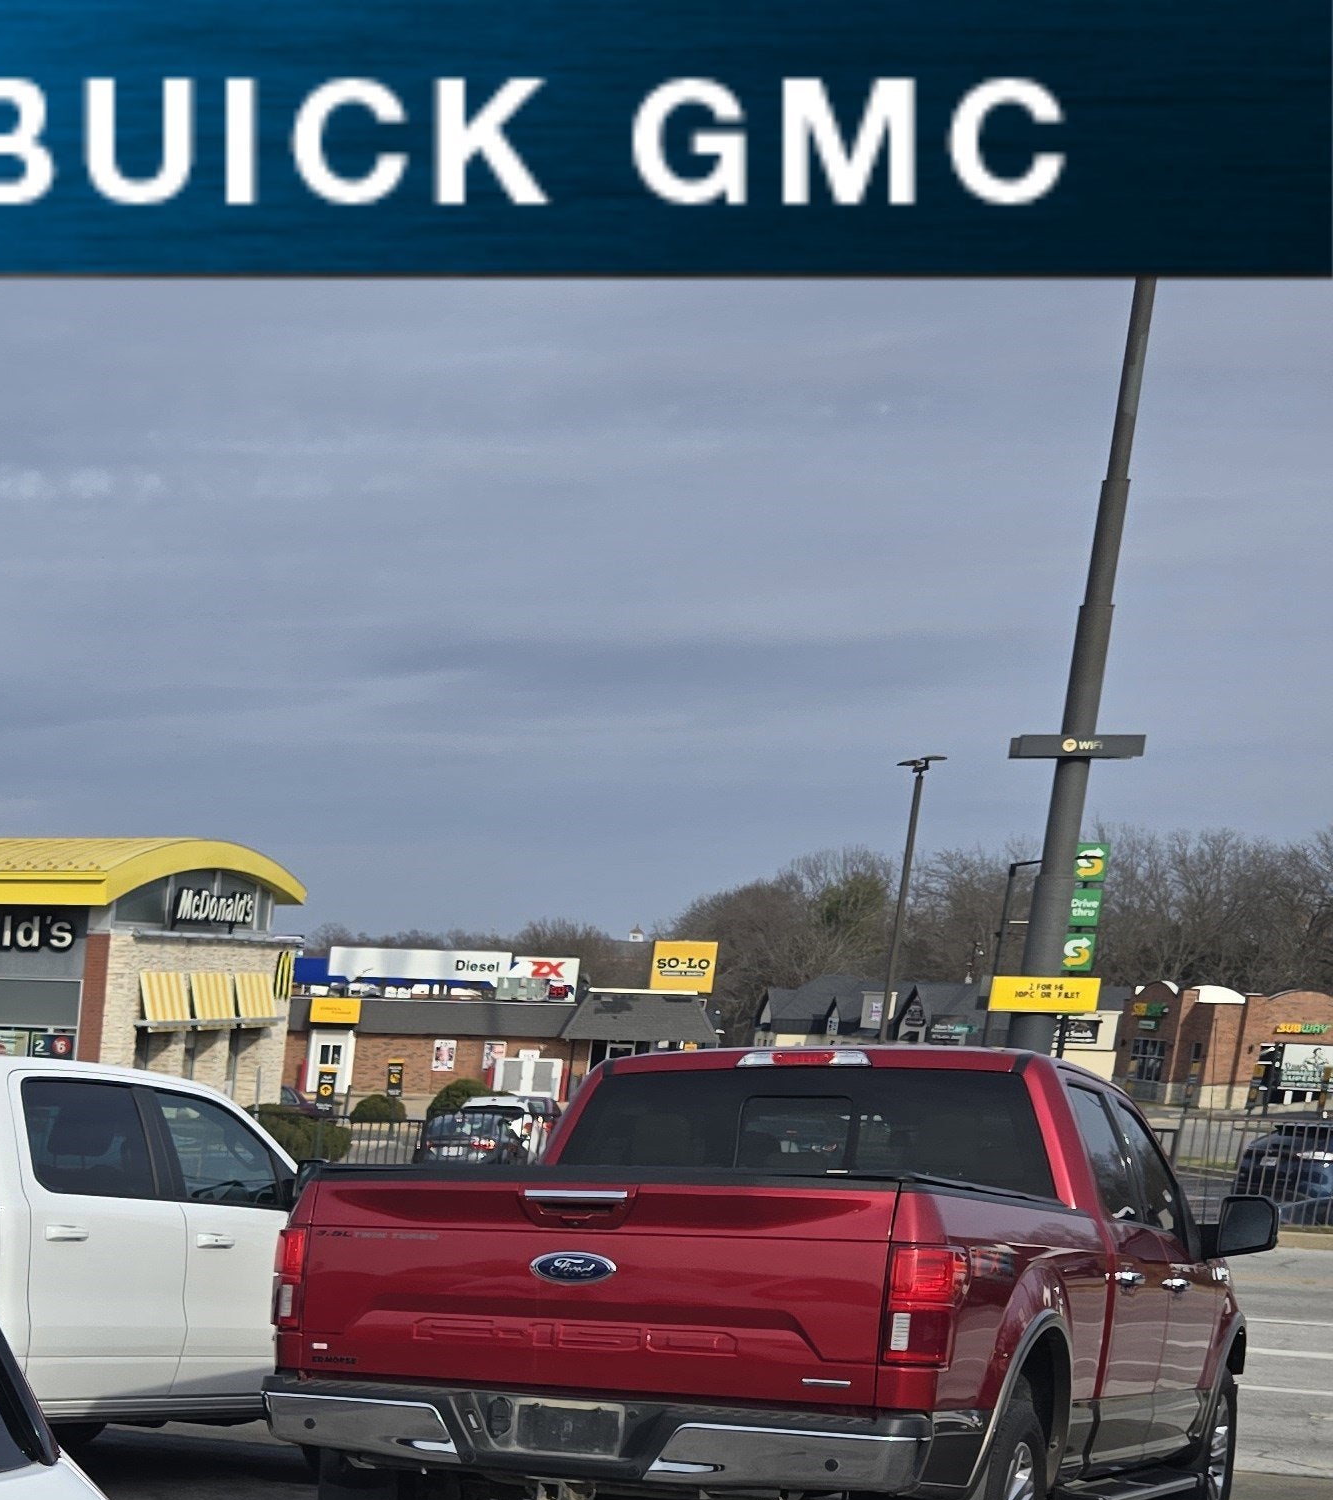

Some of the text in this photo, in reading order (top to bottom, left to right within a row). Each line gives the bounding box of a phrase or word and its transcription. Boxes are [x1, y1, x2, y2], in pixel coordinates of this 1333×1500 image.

[176, 888, 254, 923] McDonald's
[1071, 898, 1100, 908] Drive
[1071, 907, 1096, 917] thru
[455, 959, 500, 973] Diesel
[657, 957, 710, 970] SO-LO
[1275, 1022, 1332, 1034] SUBWAY
[34, 1040, 46, 1052] 2
[550, 1257, 596, 1277] Ford
